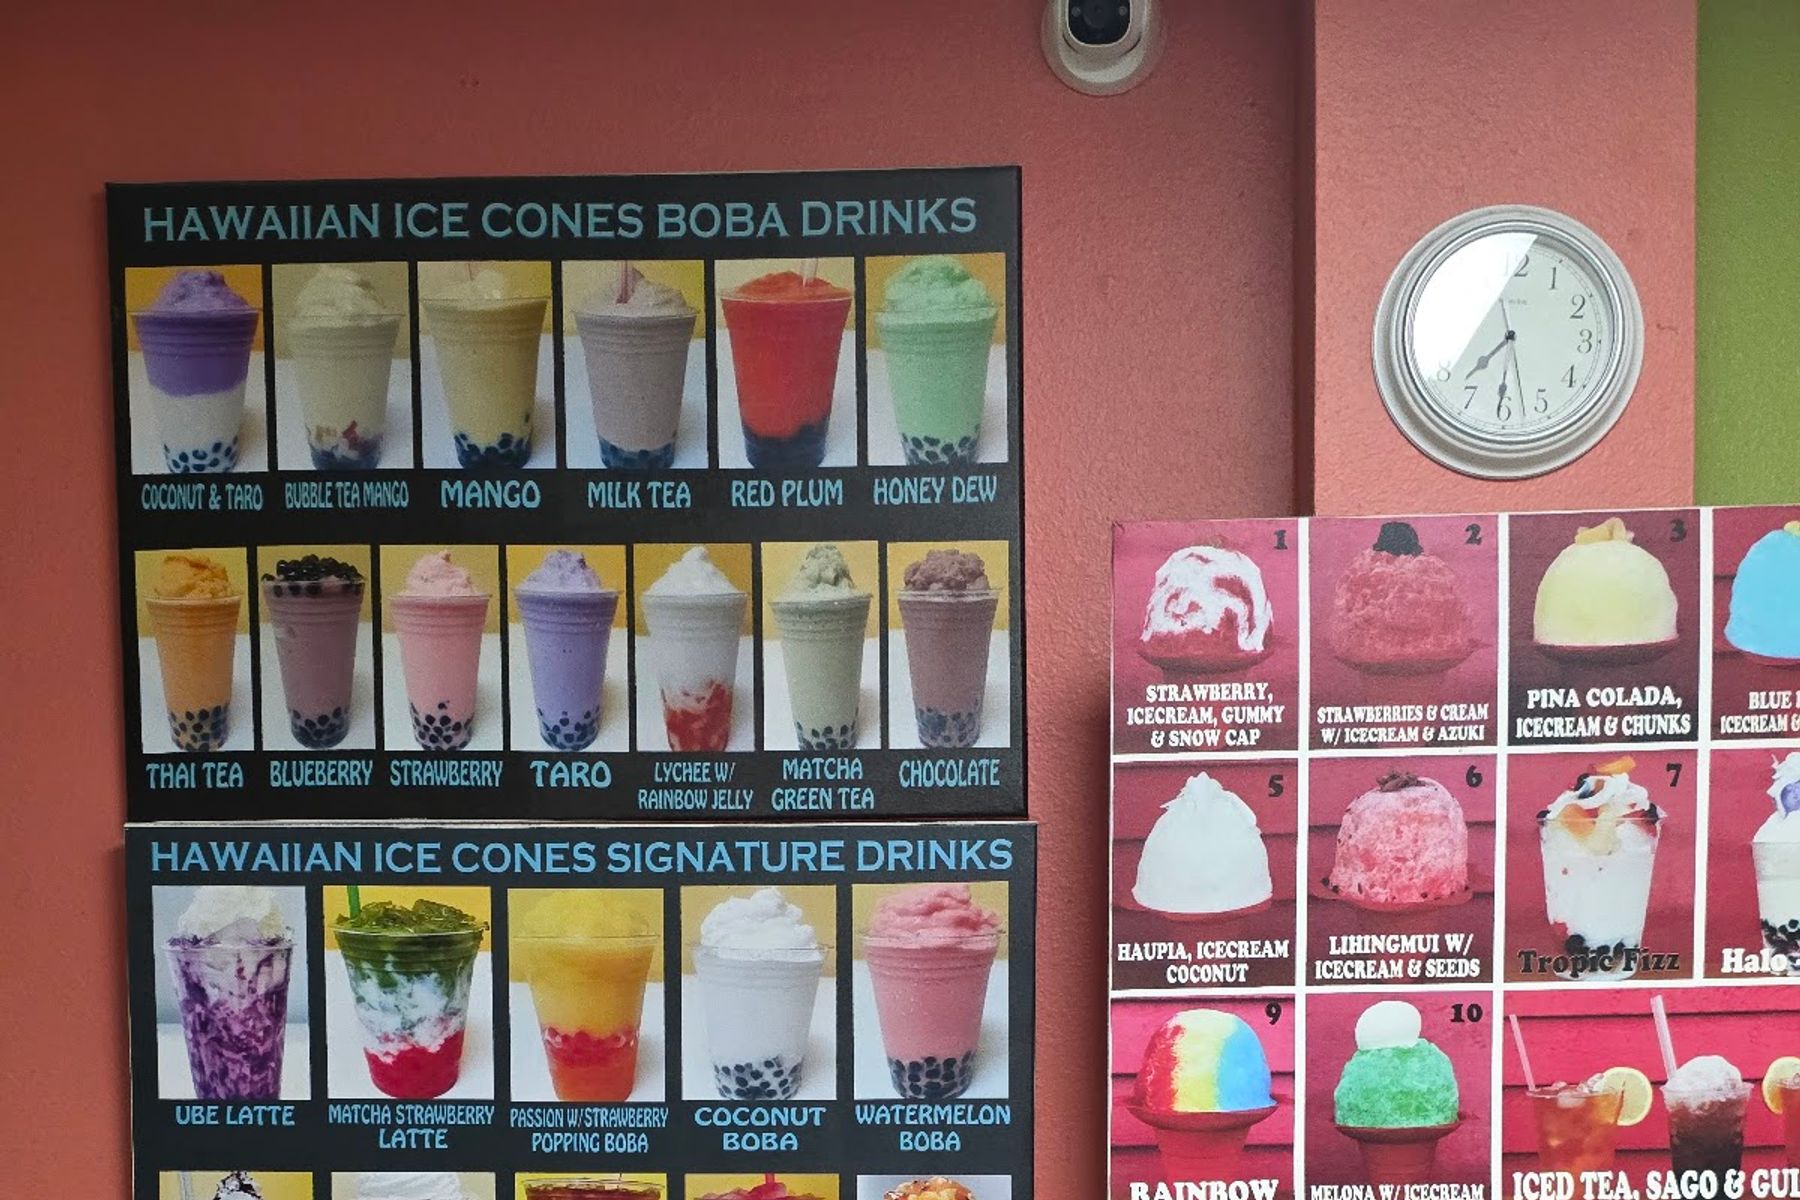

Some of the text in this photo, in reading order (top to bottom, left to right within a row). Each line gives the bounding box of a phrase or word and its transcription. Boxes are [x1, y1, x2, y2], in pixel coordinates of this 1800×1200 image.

[143, 197, 977, 242] HAWAIIAN ICE CONES BOBA DRINKS
[1569, 294, 1586, 319] 2
[1576, 329, 1593, 354] 3
[141, 483, 263, 511] COCONUT & TARO
[285, 481, 409, 510] BUBBLE TEA MANGO
[440, 480, 542, 509] MANGO
[587, 481, 692, 509] MILK TEA
[731, 479, 843, 508] RED PLUM
[873, 476, 998, 506] HONEY DEW
[1465, 524, 1483, 546] 2
[1669, 519, 1687, 542] 3
[1146, 682, 1274, 703] STRAWBERRY,
[1527, 685, 1683, 709] PINA COLADA,
[1748, 690, 1793, 710] BLUE
[1126, 705, 1285, 726] ICECREAM, GUMMY
[1317, 703, 1489, 724] STRAWBERRIES & CREAM
[1515, 713, 1692, 739] ICECREAM & CHUNKS
[146, 761, 245, 790] THAI TEA
[269, 759, 374, 788] BLUEBERRY
[389, 759, 504, 788] STRAWBERRY
[529, 760, 613, 788] TARO
[654, 761, 735, 783] LYCHEE W/
[782, 757, 864, 781] MATCHA
[899, 758, 1001, 788] CHOCOLATE
[1465, 764, 1484, 788] 6
[1665, 763, 1683, 787] 7
[638, 788, 754, 811] RAINBOW JELLY
[771, 788, 876, 811] GREEN TEA
[151, 838, 1014, 873] HAWAIIAN ICE CONES SIGNATURE DRINKS
[1117, 939, 1290, 962] HAUPIA, ICECREAM
[1328, 933, 1475, 956] LIHINGMUI W/
[1315, 958, 1481, 980] ICECREAM & SEEDS
[1518, 947, 1680, 977] Tropic Fizz
[1720, 947, 1788, 974] Halo
[1166, 963, 1250, 983] COCONUT
[1264, 1000, 1282, 1025] 9
[1450, 1003, 1484, 1023] 10
[175, 1105, 296, 1126] UBE LATTE
[328, 1104, 495, 1125] MATCHA STRAWBERRY
[693, 1106, 827, 1127] COCONUT
[855, 1104, 1011, 1126] WATERMELON
[378, 1128, 449, 1150] LATTE
[532, 1132, 649, 1154] POPPING BOBA
[722, 1131, 799, 1151] BOBA
[899, 1131, 961, 1152] BOBA
[1645, 1169, 1719, 1200] SAGO
[1723, 1168, 1746, 1199] &
